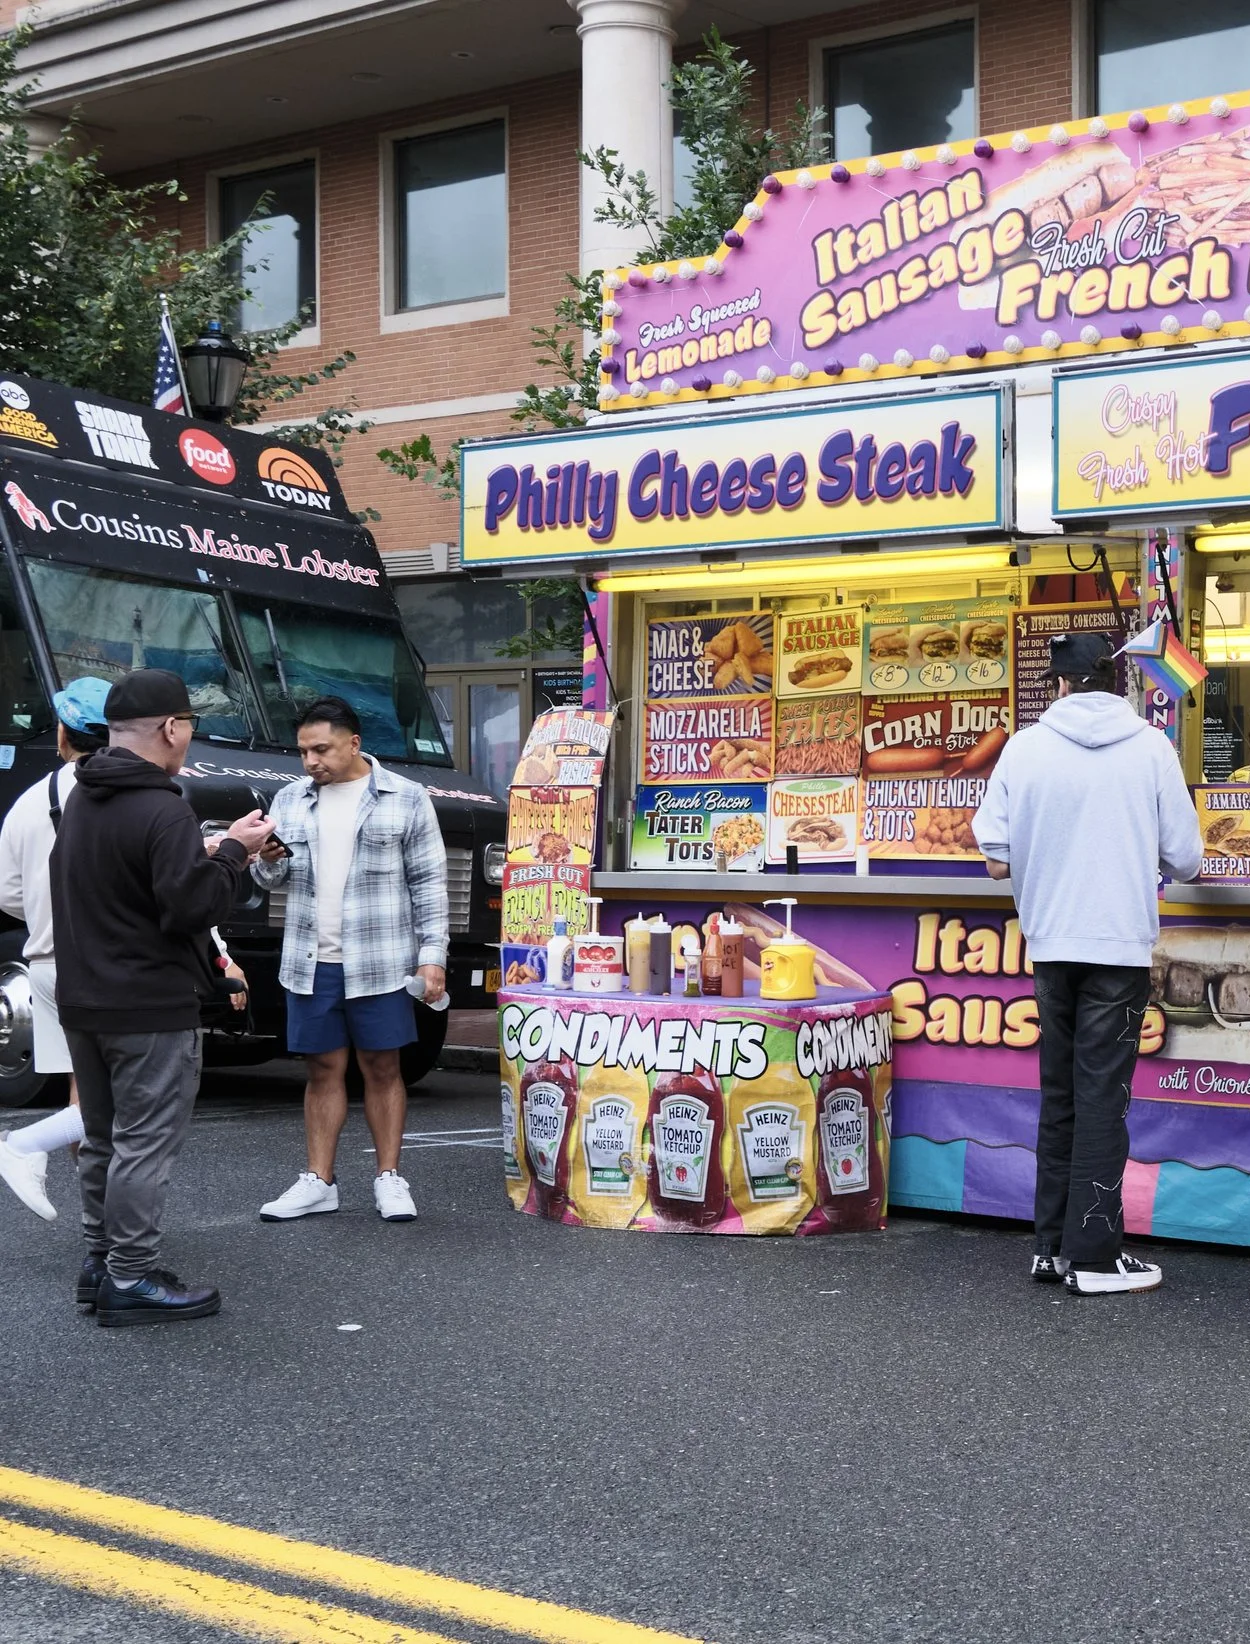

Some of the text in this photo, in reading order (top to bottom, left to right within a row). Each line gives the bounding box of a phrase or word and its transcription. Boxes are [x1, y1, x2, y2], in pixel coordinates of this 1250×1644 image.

[813, 168, 985, 287] Italian
[1031, 208, 1180, 277] Fresh Cut
[801, 208, 1027, 350] Sausage
[996, 236, 1230, 326] French
[638, 288, 761, 349] Fresh Squeezed
[624, 317, 772, 384] Lemonade
[1, 388, 28, 402] abc
[3, 407, 37, 421] GOOD
[1102, 384, 1176, 434] Crispy
[74, 401, 149, 441] SHARK
[0, 424, 58, 444] AMERICA
[82, 427, 159, 470] TANK
[184, 439, 231, 469] food
[199, 462, 228, 474] network
[1077, 429, 1208, 499] Fresh Hot
[485, 420, 976, 543] Philly Cheese Steak
[262, 481, 331, 511] TODAY
[51, 500, 380, 588] Cousins Maine Lobster
[786, 612, 857, 636] ITALIAN
[872, 616, 909, 624] CHEESEBURGER
[920, 613, 956, 622] CHEESEBURGER
[967, 609, 1004, 619] CHEESEBURGER
[1030, 614, 1070, 631] NUTMEG
[653, 627, 704, 659] MAC &
[783, 631, 860, 653] SAUSAGE
[1018, 639, 1044, 648] HOT DOG
[1018, 649, 1051, 658] CHEESE DO
[652, 660, 714, 692] CHEESE
[1019, 691, 1039, 699] PHILLY
[781, 702, 814, 718] SWEET
[818, 695, 855, 712] POTATO
[1019, 702, 1043, 710] CHICKEN
[650, 707, 762, 740] MOZZARELLA
[778, 709, 858, 748] FRIES
[864, 701, 1009, 753] CORN DOGS
[914, 736, 931, 749] On
[946, 733, 978, 750] Stick
[650, 743, 711, 774] STICKS
[194, 762, 309, 782] Cousin
[801, 780, 827, 792] Philly
[866, 779, 988, 808] CHICKEN TENDER
[655, 791, 752, 812] Ranch Bacon
[773, 786, 855, 816] CHEESESTEAK
[644, 810, 704, 836] TATER
[863, 809, 915, 841] & TOTS
[665, 838, 714, 863] TOTS
[509, 865, 584, 885] FRESH CUT
[1202, 857, 1228, 875] BEEF
[503, 881, 590, 927] FRENCH FRIES
[912, 912, 1034, 978] Ital
[887, 978, 1165, 1056] Sause
[502, 1005, 767, 1079] CONDIMENTS
[1158, 1066, 1190, 1093] with
[533, 1094, 556, 1108] HEINZ
[600, 1105, 625, 1118] HEINZ
[831, 1100, 855, 1114] HEINZ
[529, 1113, 559, 1130] TOMATO
[669, 1107, 698, 1121] HEINZ
[756, 1113, 788, 1125] HEINZ
[530, 1127, 557, 1139] KETCHUP
[595, 1129, 623, 1139] YELLOW
[662, 1127, 702, 1143] TOMATO
[827, 1120, 861, 1136] TOMATO
[592, 1140, 624, 1150] MUSTARD
[664, 1141, 701, 1154] KETCHUP
[755, 1136, 789, 1147] YELLOW
[830, 1134, 860, 1147] KETCHUP
[753, 1147, 791, 1158] MUSTARD
